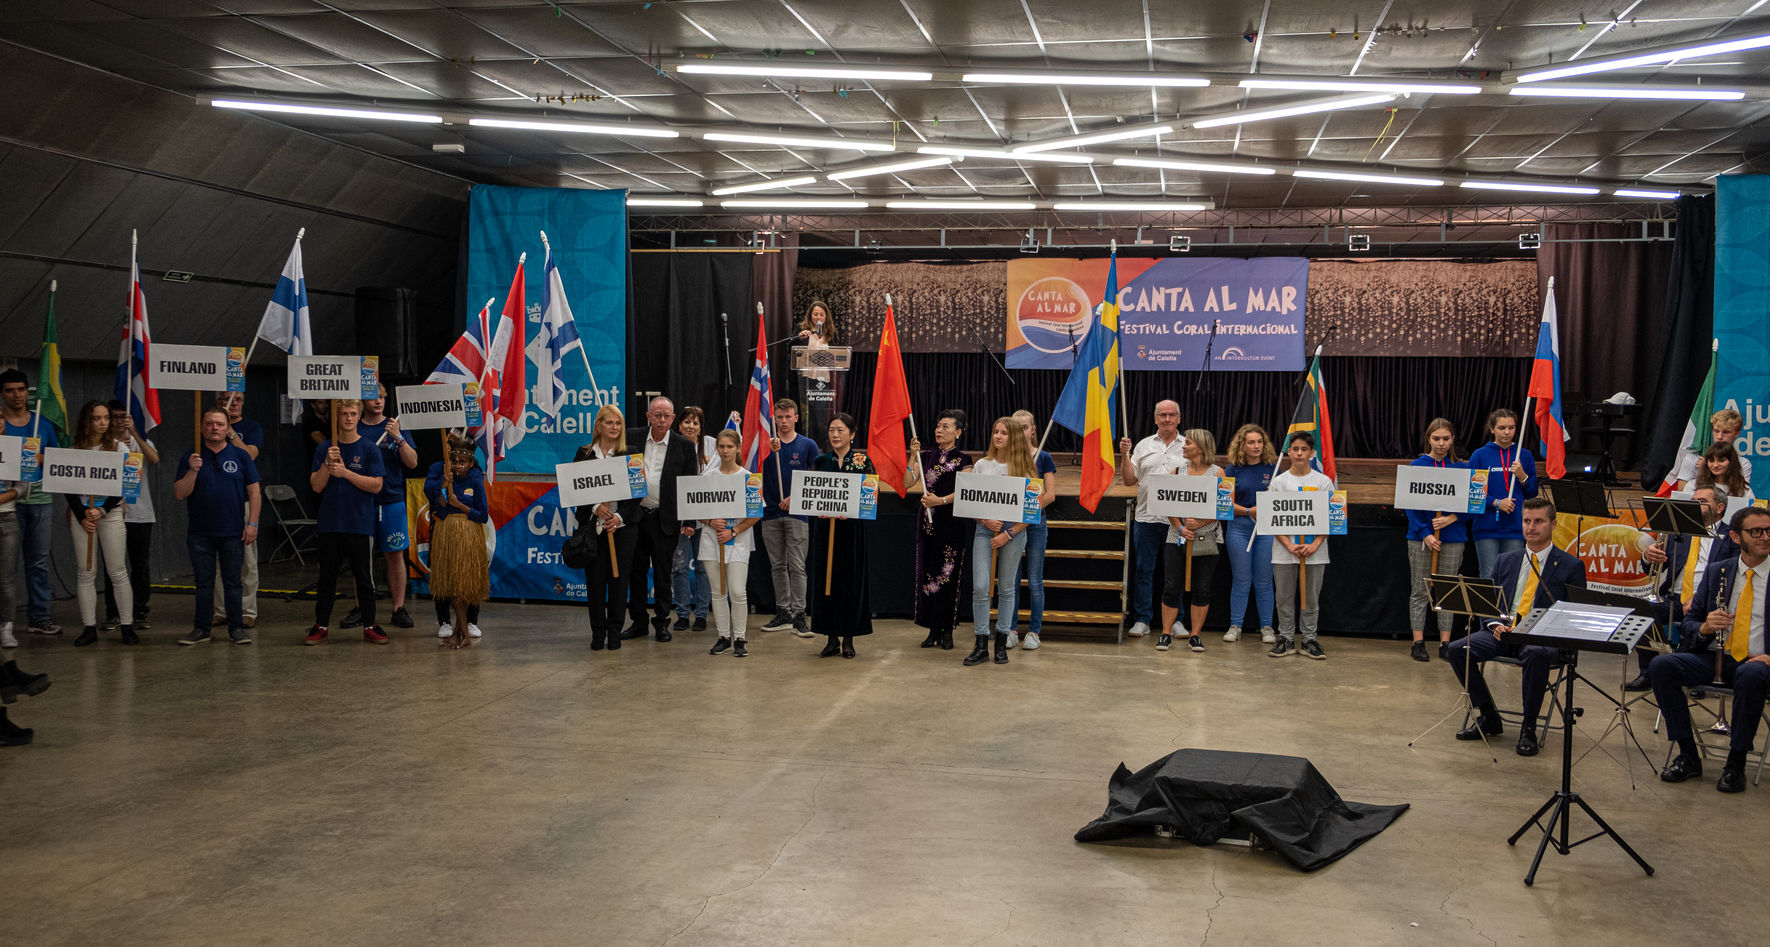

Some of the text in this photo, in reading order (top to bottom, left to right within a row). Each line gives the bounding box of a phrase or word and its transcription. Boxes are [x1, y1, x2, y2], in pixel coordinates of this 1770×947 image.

[1028, 290, 1063, 301] CANTA
[1119, 285, 1297, 315] CANTA AL MAR
[1037, 302, 1076, 314] AL MAR
[1149, 349, 1182, 357] Ajuntament
[160, 360, 216, 375] FINLAND
[306, 363, 344, 376] GREAT
[300, 379, 350, 391] BRITAIN
[400, 399, 463, 414] INDONESIA
[525, 411, 596, 435] Calell
[49, 464, 117, 480] COSTA RICA
[573, 474, 615, 490] ISRAEL
[803, 476, 849, 489] PEOPLE'S
[1409, 481, 1456, 496] RUSSIA
[686, 490, 736, 504] NORWAY
[802, 488, 849, 501] REPUBLIC
[960, 488, 1018, 506] ROMANIA
[1157, 489, 1207, 503] SWEDEN
[801, 499, 814, 511] OF
[816, 500, 848, 512] CHINA
[1272, 499, 1313, 512] SOUTH
[527, 505, 579, 537] CAN
[1271, 514, 1315, 527] AFRICA
[1576, 542, 1627, 558] CANTA
[1588, 558, 1609, 573] AL
